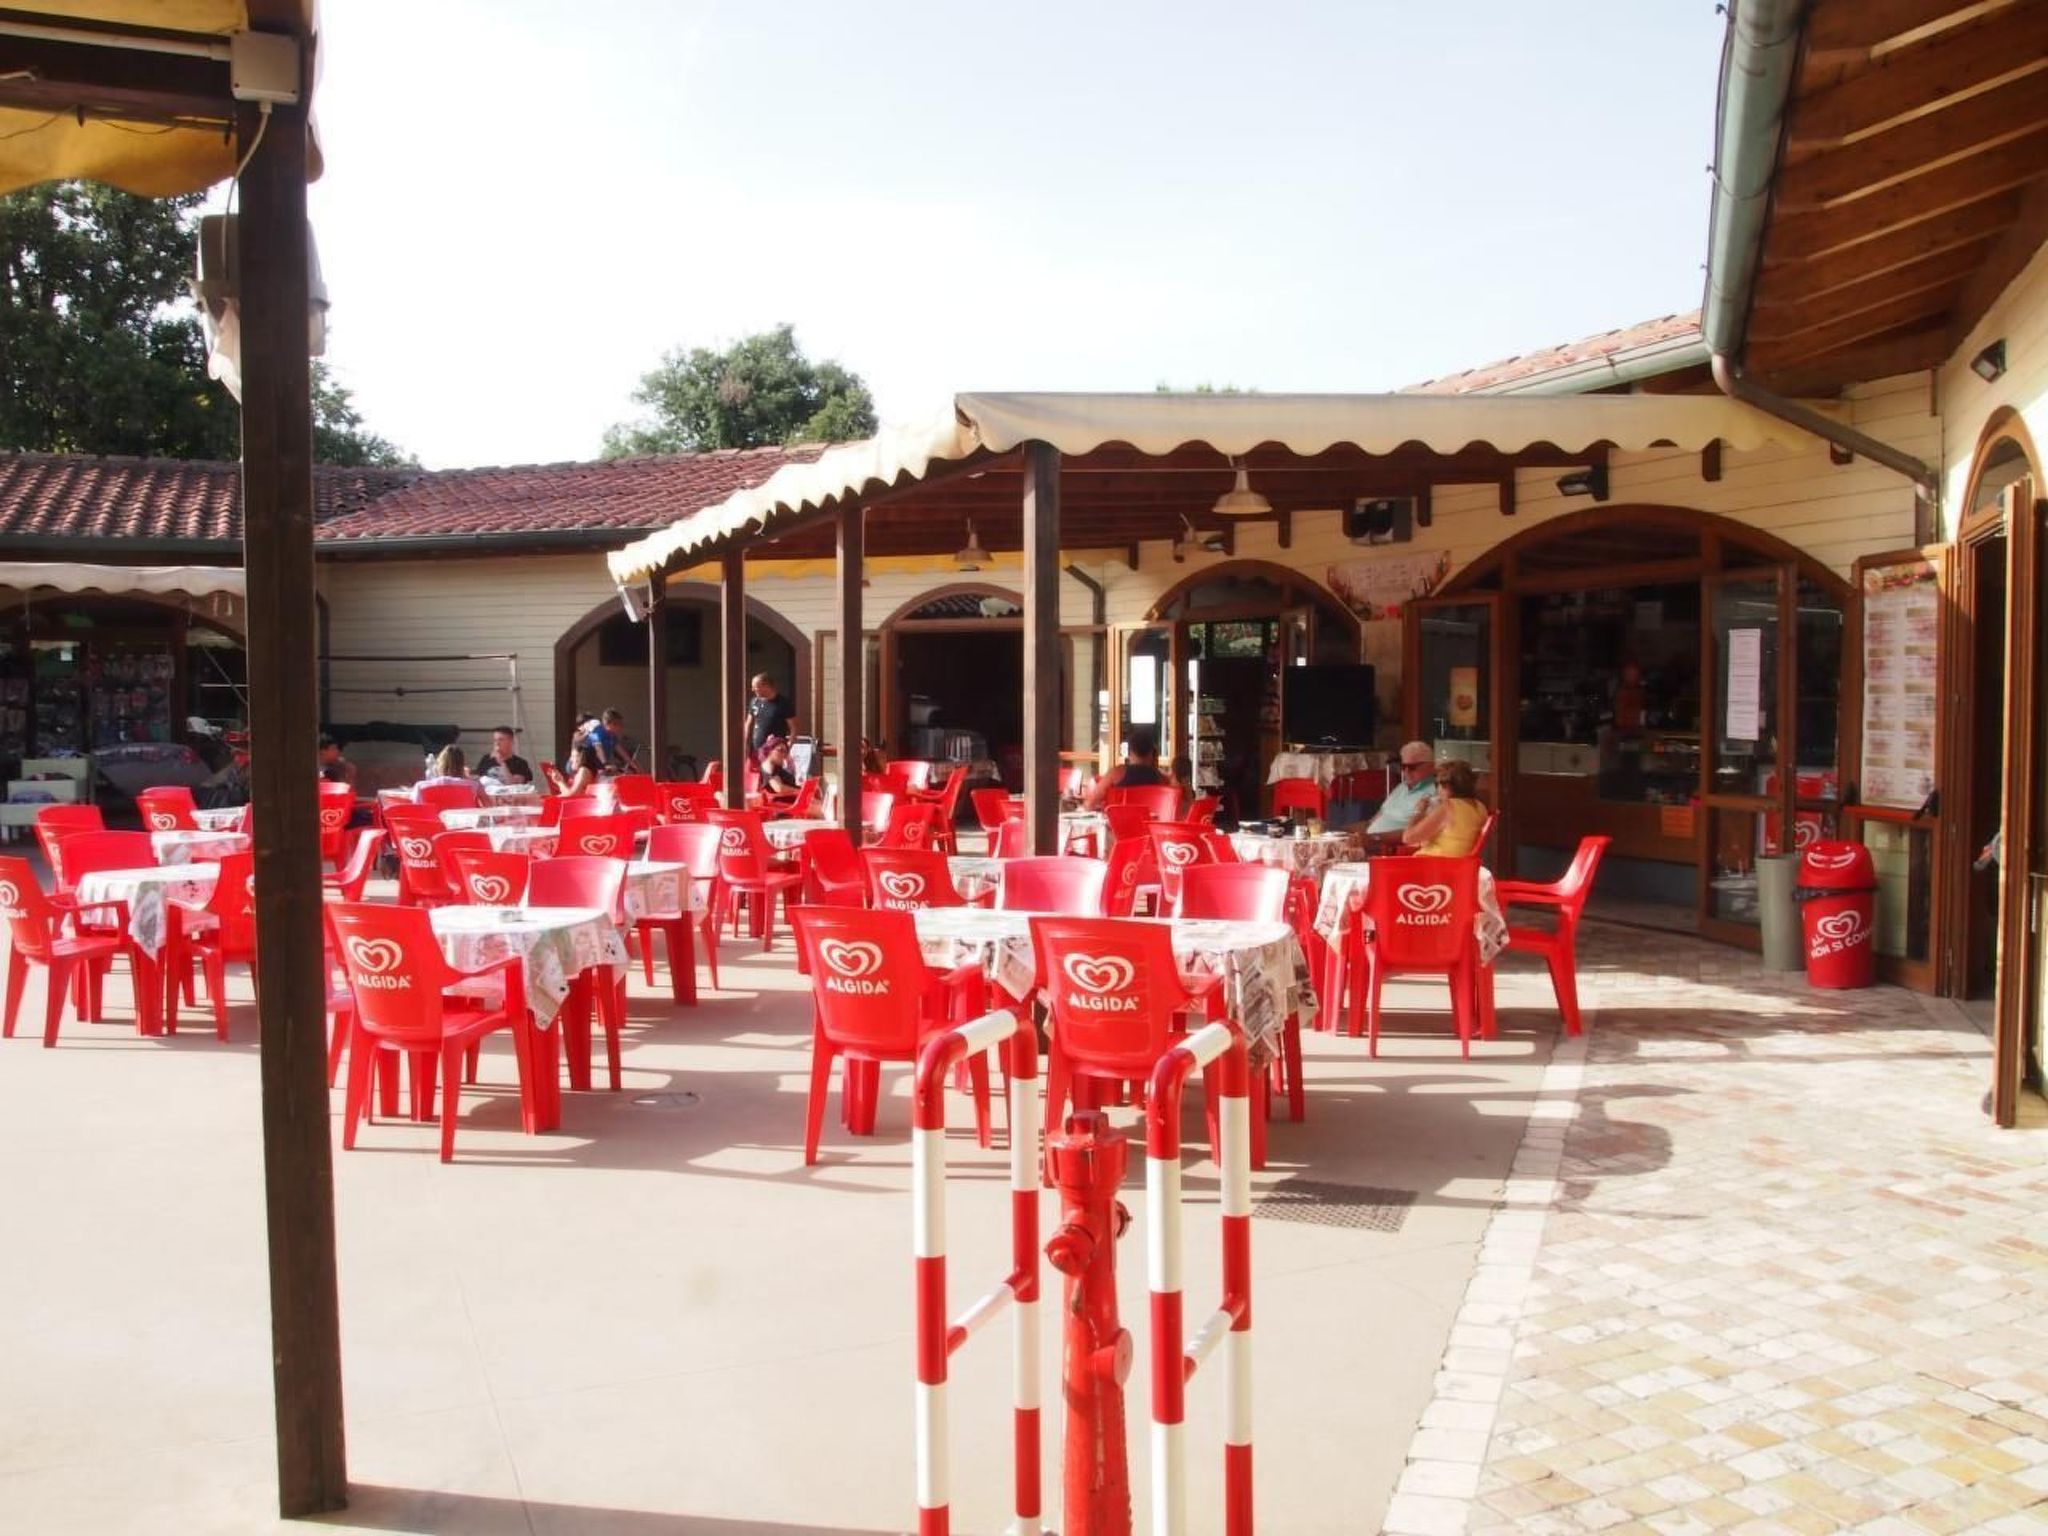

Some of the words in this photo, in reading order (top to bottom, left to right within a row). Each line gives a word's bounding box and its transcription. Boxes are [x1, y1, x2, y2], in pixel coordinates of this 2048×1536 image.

[885, 898, 929, 911] ALGIDA
[1396, 913, 1452, 926] ALGIDA
[357, 973, 412, 990] ALGIDA
[826, 975, 889, 995] ALGIDA
[1068, 992, 1140, 1012] ALGIDA
